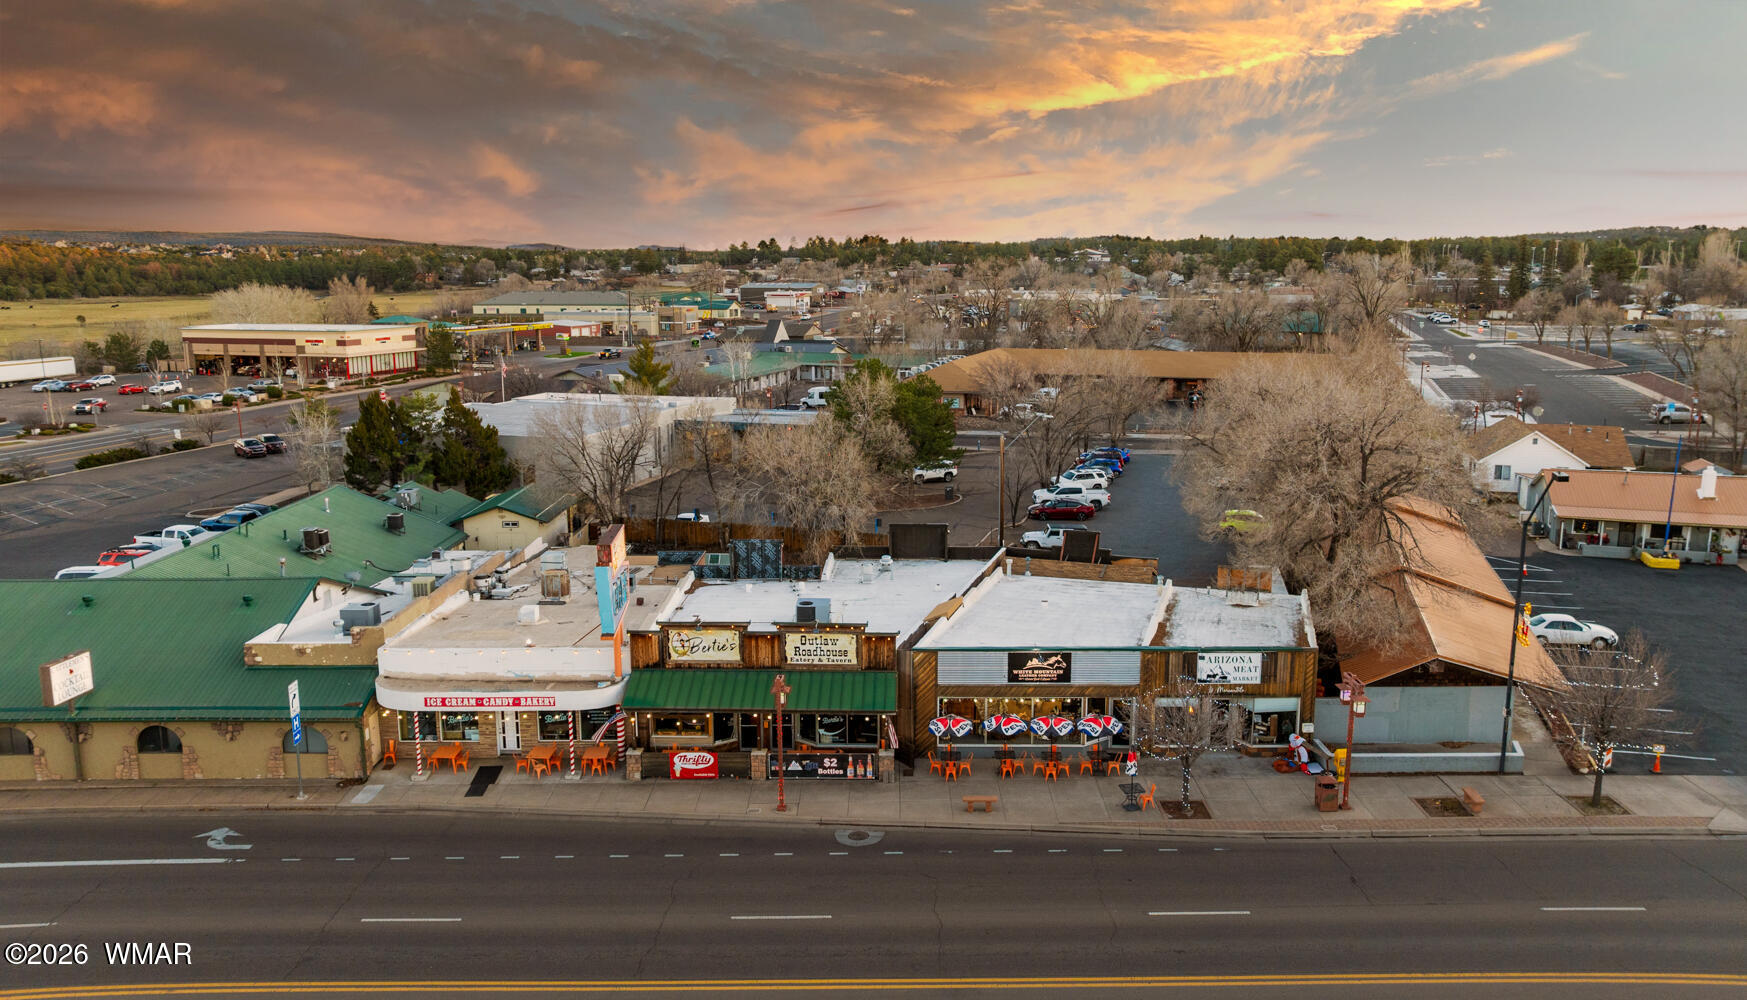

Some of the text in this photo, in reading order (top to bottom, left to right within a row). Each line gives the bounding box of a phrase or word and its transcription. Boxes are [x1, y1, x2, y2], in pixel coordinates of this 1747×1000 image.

[685, 637, 737, 654] Bertie's
[801, 635, 839, 646] Outlaw
[793, 646, 848, 657] Roadhouse
[1207, 656, 1253, 664] ARIZONA
[426, 697, 555, 706] ICE CREAM CANDY BAKERY
[293, 716, 300, 730] H
[447, 713, 473, 724] Beie's
[678, 754, 712, 767] Thrifty
[823, 757, 838, 768] $2
